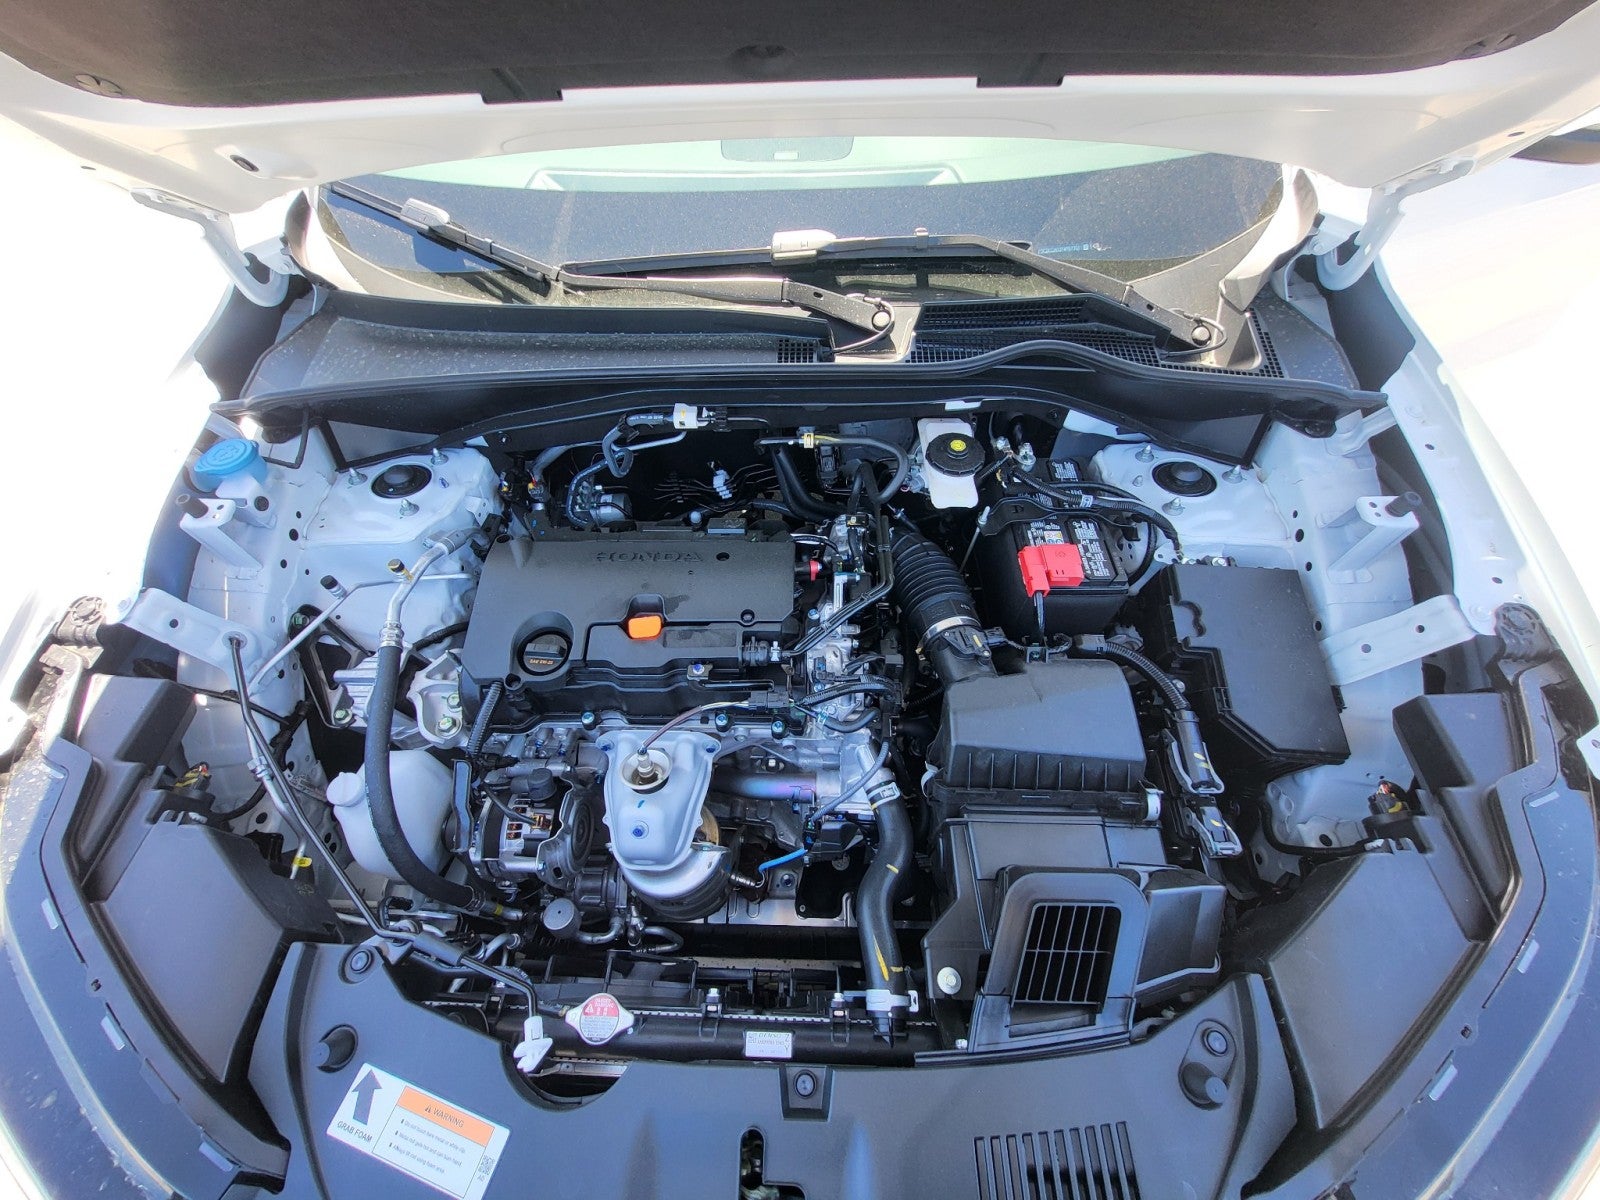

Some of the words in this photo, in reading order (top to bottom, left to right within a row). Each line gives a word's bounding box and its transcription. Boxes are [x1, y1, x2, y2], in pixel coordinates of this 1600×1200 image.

[597, 552, 704, 562] HONDA
[433, 1107, 464, 1128] WARNING
[337, 1120, 355, 1136] GRAB
[354, 1128, 372, 1142] FOAM
